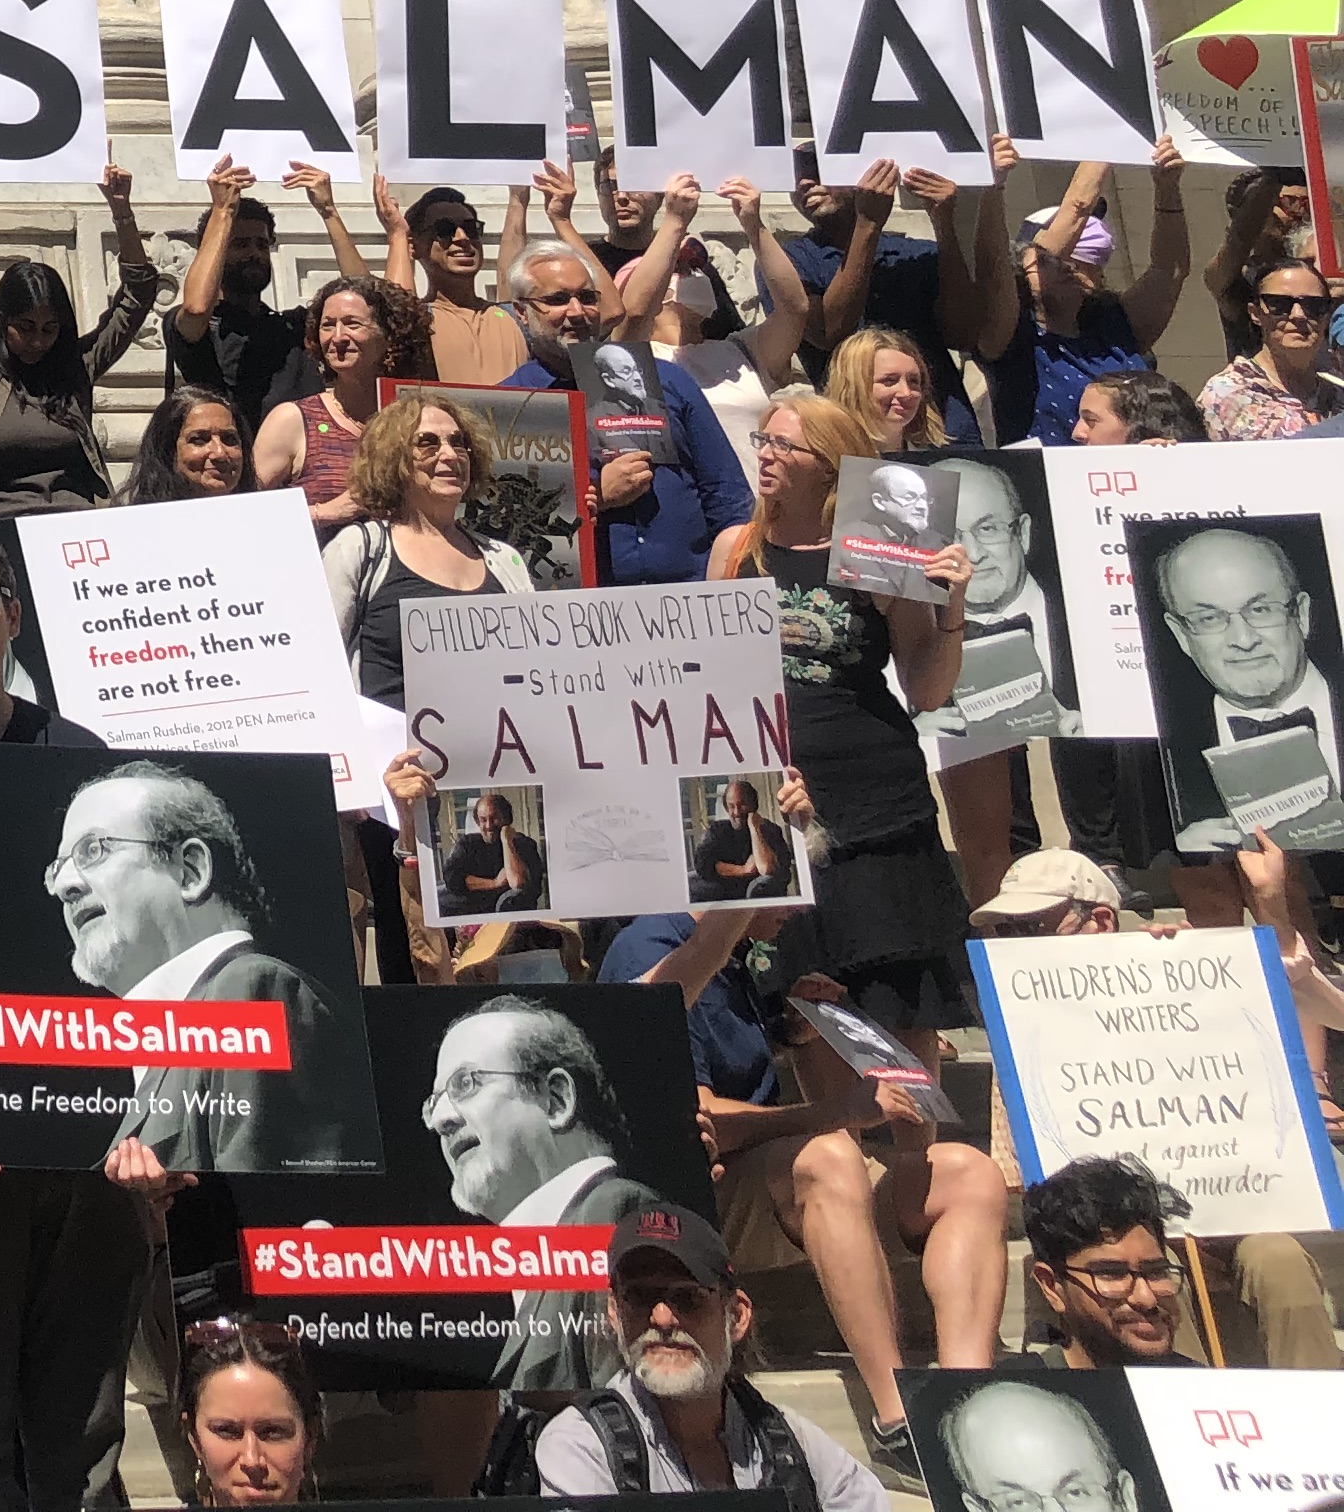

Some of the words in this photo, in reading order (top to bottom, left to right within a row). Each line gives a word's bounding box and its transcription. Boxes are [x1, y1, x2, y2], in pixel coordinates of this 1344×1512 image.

[1259, 99, 1284, 113] OF
[485, 391, 571, 463] Verses
[1095, 506, 1112, 525] If
[73, 579, 90, 601] If
[96, 582, 129, 598] we
[136, 576, 172, 594] are
[178, 567, 217, 589] not
[82, 604, 192, 634] confident
[197, 598, 221, 621] of
[227, 600, 264, 617] our
[407, 601, 562, 653] CHILDREN'S
[568, 600, 631, 649] BOOK
[635, 589, 775, 641] WRITERS
[89, 640, 196, 668] freedom,
[200, 633, 254, 655] then
[258, 631, 291, 649] we
[98, 684, 135, 702] are
[140, 674, 180, 697] not
[184, 669, 241, 692] free.
[107, 728, 150, 744] Salman
[153, 719, 204, 739] Rushdie,
[207, 720, 234, 733] 2012
[235, 712, 263, 728] PEN
[267, 709, 316, 725] America
[412, 693, 790, 780] SALMAN
[1012, 958, 1152, 1001] CHILDREN'S
[1163, 955, 1242, 992] BOOK
[1095, 1002, 1200, 1034] WRITERS
[1061, 1058, 1155, 1092] STAND
[1166, 1051, 1244, 1082] WITH
[31, 1086, 141, 1116] Freedom
[148, 1093, 174, 1116] to
[182, 1090, 252, 1117] Write
[1075, 1091, 1249, 1138] SALMAN
[1162, 1137, 1240, 1170] against
[1186, 1164, 1283, 1196] murder
[255, 1236, 609, 1279] #StandWithSalma
[287, 1313, 370, 1346] Defend
[376, 1313, 413, 1338] the
[420, 1311, 521, 1339] Freedom
[529, 1315, 551, 1338] to
[562, 1311, 610, 1338] Writ
[1215, 1461, 1241, 1491] If
[1248, 1473, 1294, 1491] we
